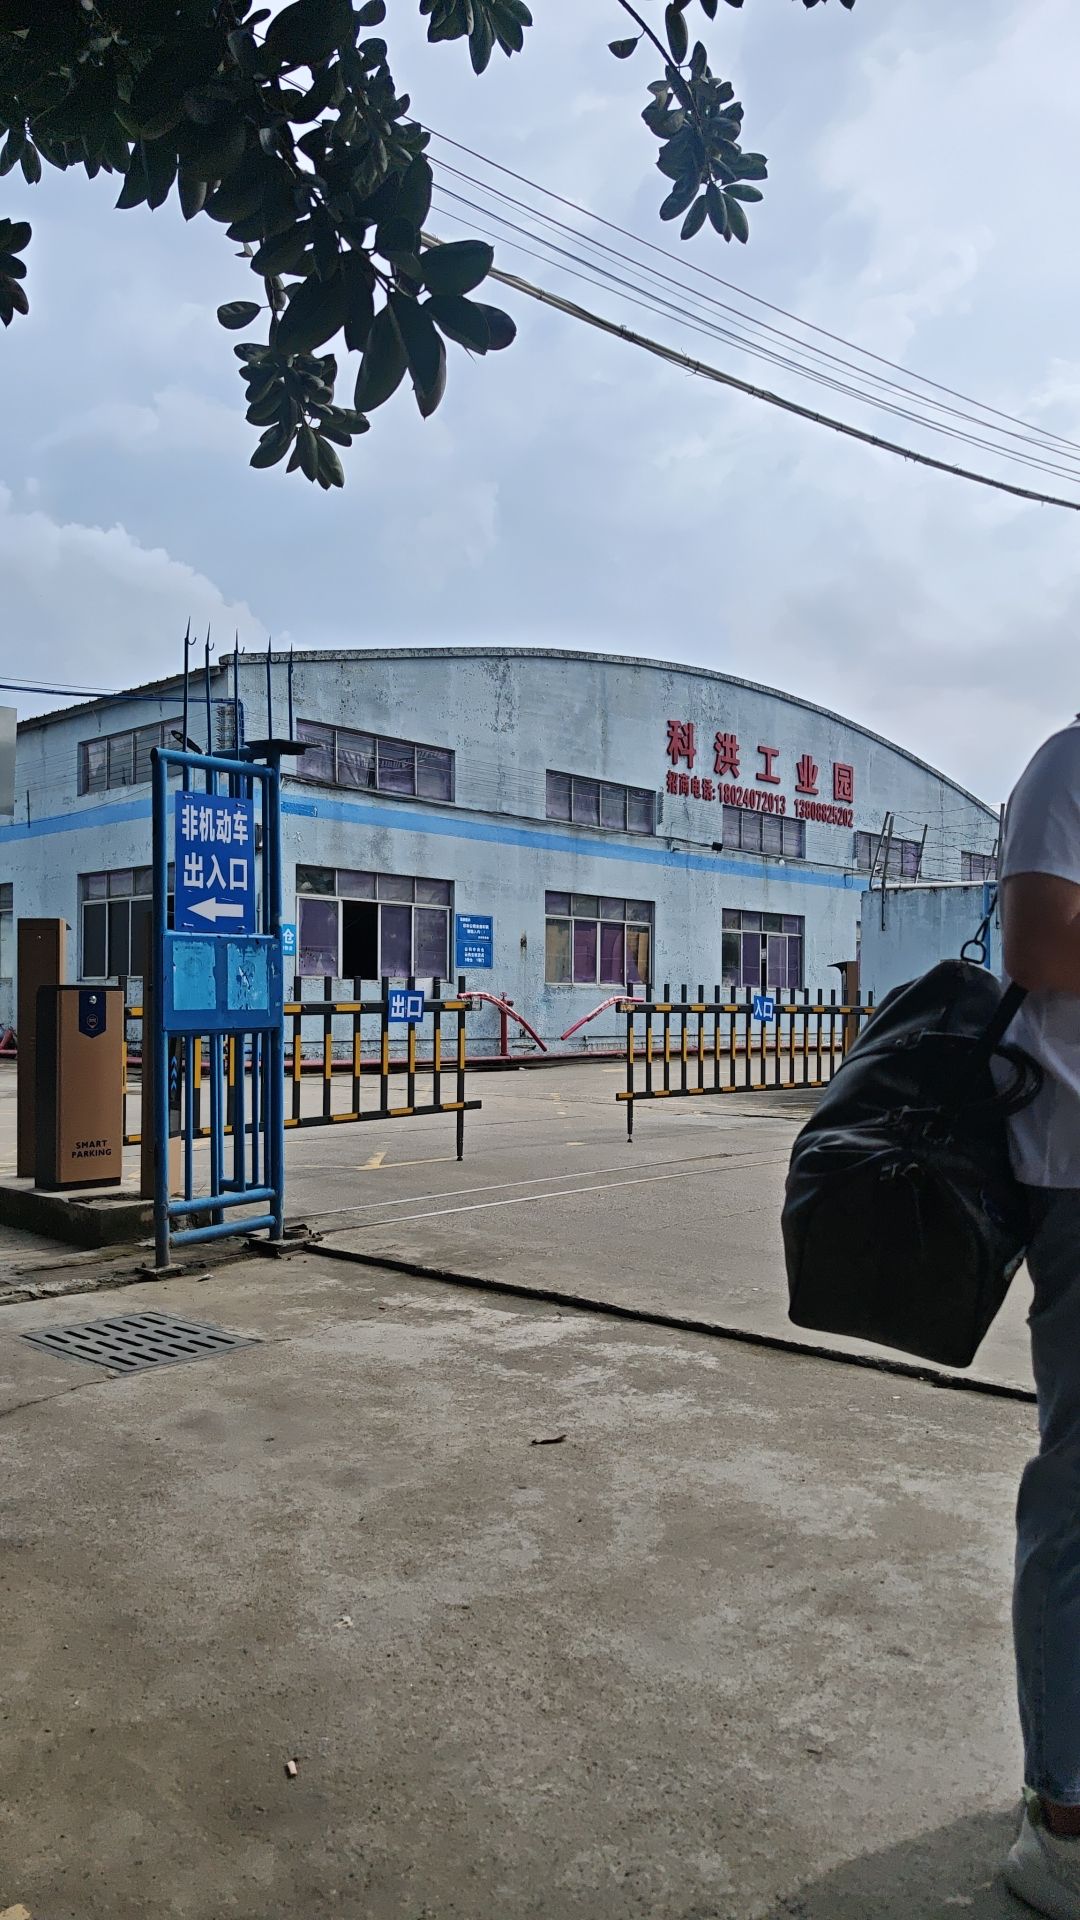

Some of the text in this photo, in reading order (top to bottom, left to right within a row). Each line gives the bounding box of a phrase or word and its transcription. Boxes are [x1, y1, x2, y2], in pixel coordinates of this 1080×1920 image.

[667, 720, 854, 803] 科洪工业园
[181, 804, 249, 846] 非机动车
[183, 852, 248, 891] 出入口
[391, 994, 422, 1018] 出口
[755, 999, 772, 1018] 入口
[71, 1149, 112, 1158] PARKING
[75, 1140, 107, 1149] SMART
